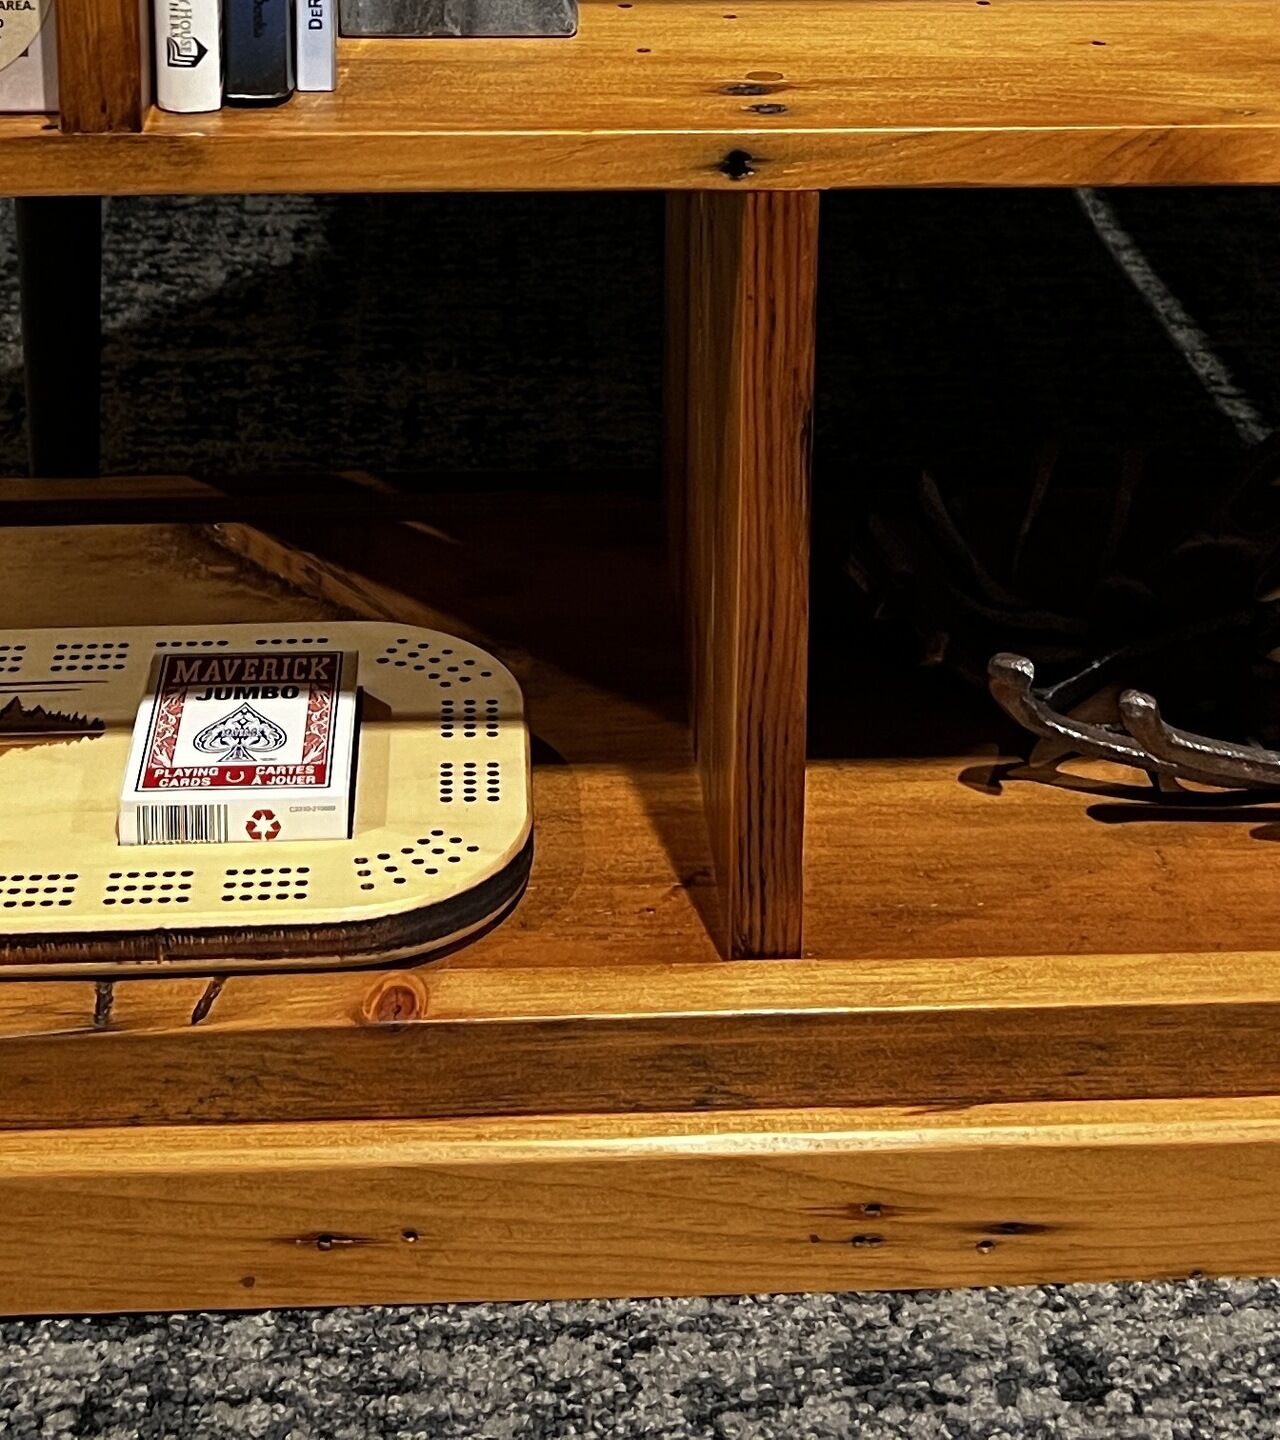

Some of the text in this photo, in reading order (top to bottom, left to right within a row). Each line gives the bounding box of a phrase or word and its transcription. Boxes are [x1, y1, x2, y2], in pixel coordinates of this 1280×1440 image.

[172, 658, 331, 683] MAVERICK
[195, 685, 299, 701] JUMBO
[153, 767, 219, 778] PLAYING
[255, 766, 315, 776] CARTES
[158, 777, 211, 787] CARDS
[266, 775, 317, 785] JOUER
